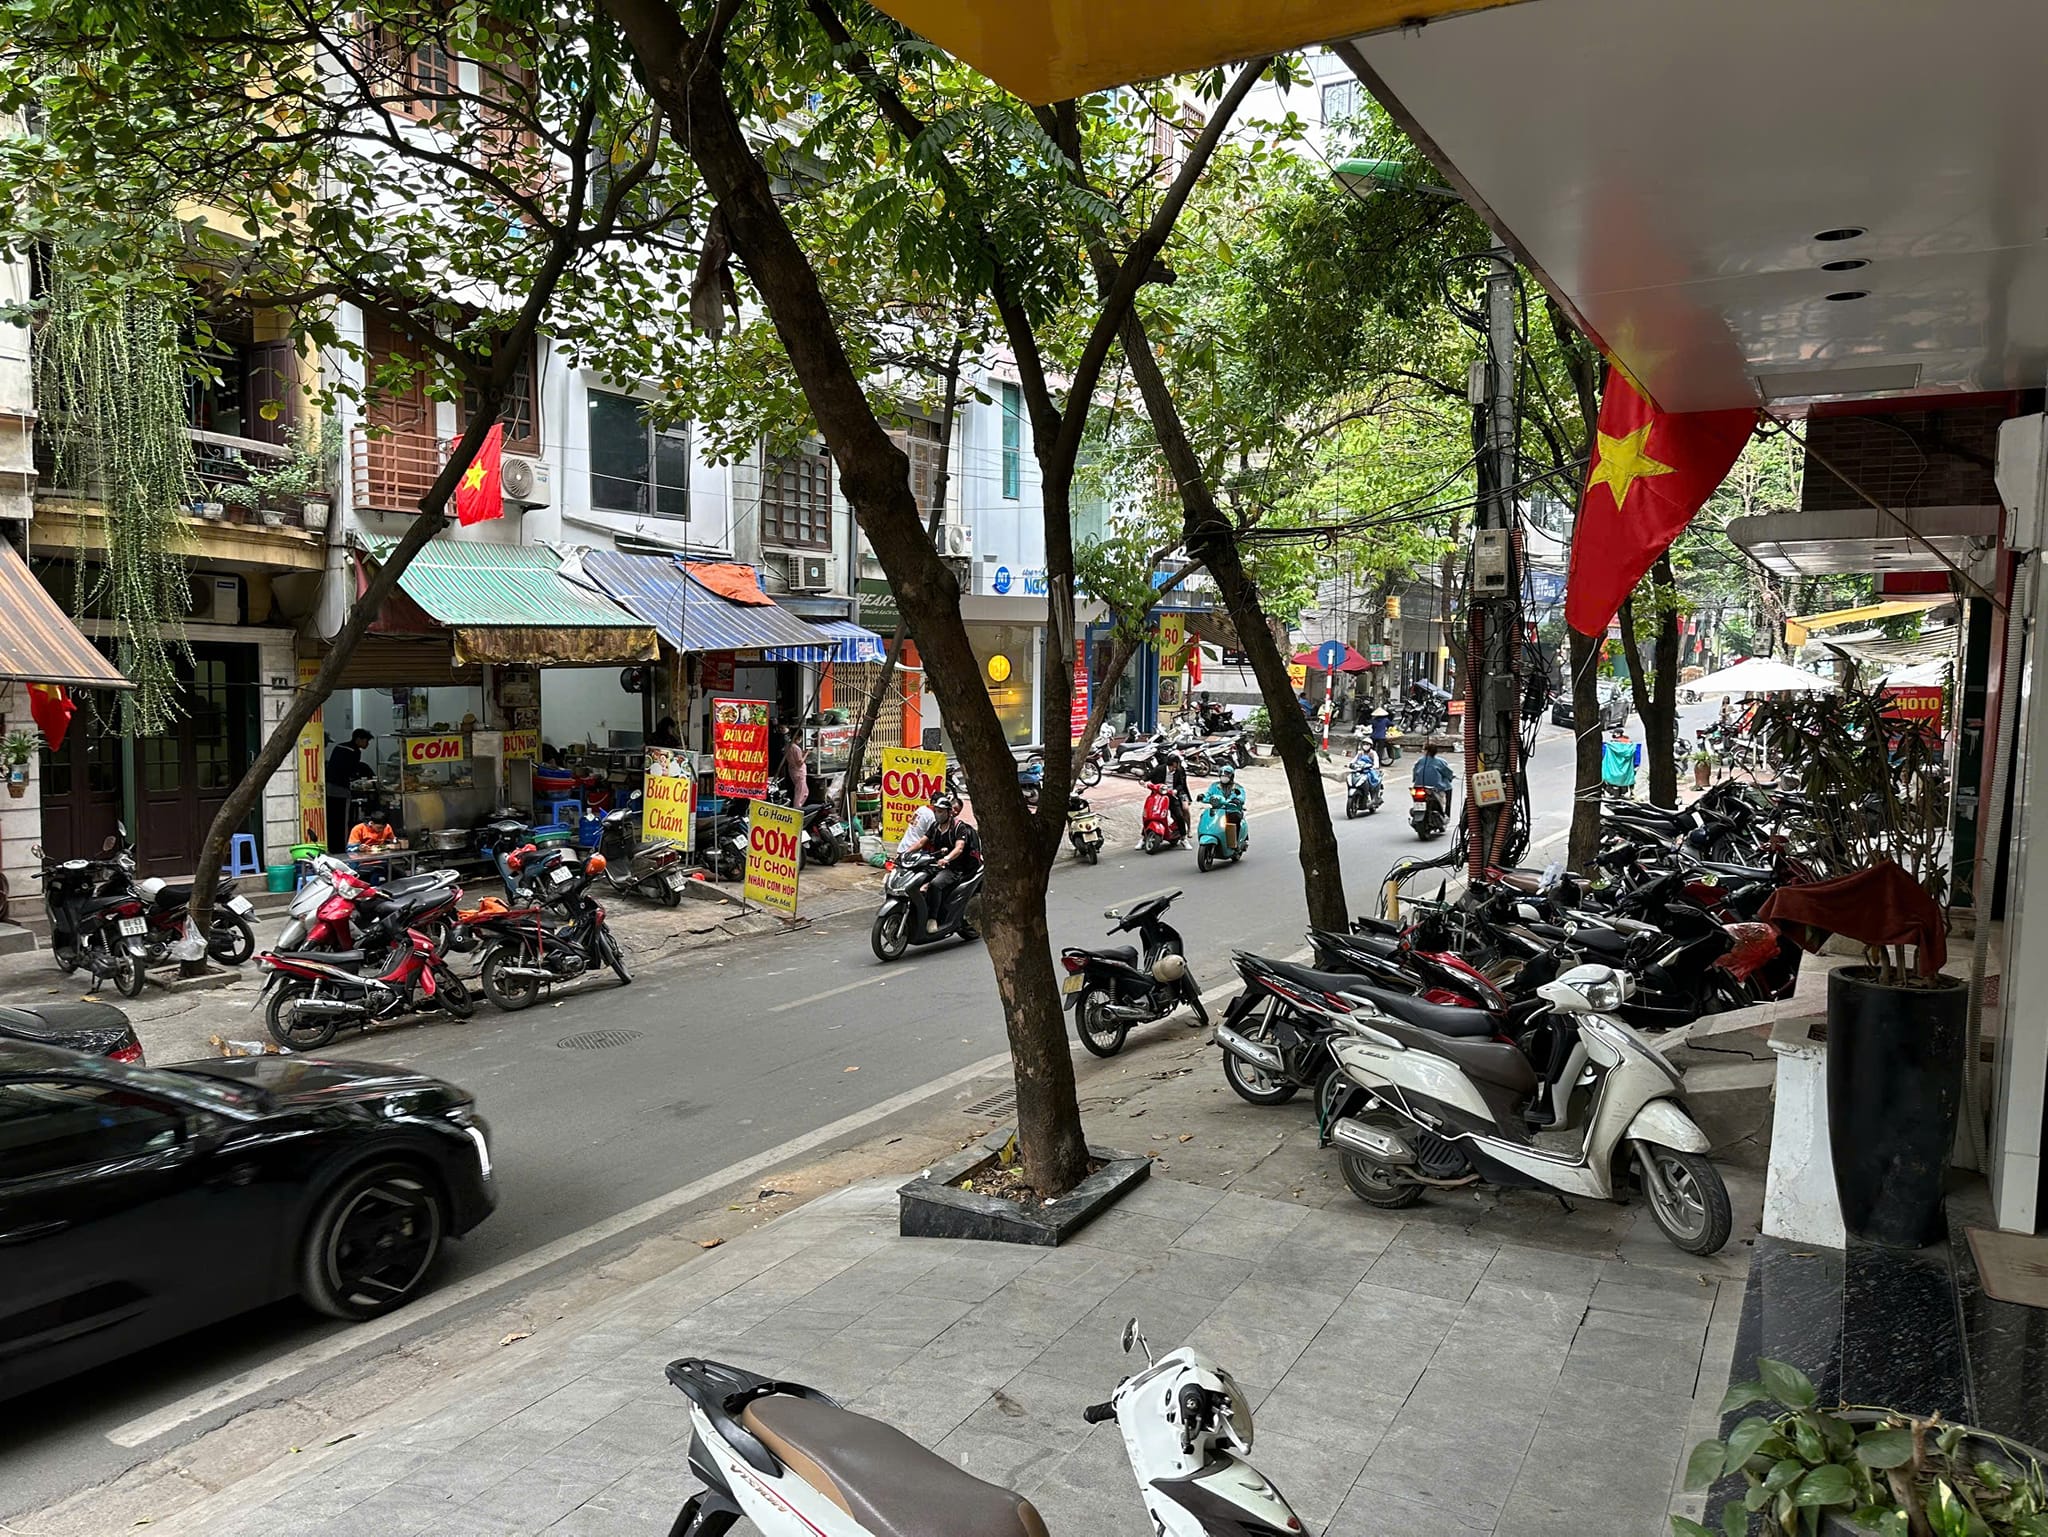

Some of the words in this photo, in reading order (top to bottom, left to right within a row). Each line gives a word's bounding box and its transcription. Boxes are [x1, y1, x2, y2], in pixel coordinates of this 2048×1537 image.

[412, 738, 460, 760] CƠM
[646, 776, 670, 801] Bún
[672, 780, 689, 804] Cá
[883, 768, 944, 800] CƠM
[649, 808, 684, 833] Chấm
[770, 810, 793, 824] Hạnh
[750, 826, 798, 862] CƠM
[748, 855, 761, 872] TỰ
[764, 860, 796, 880] CHỌN
